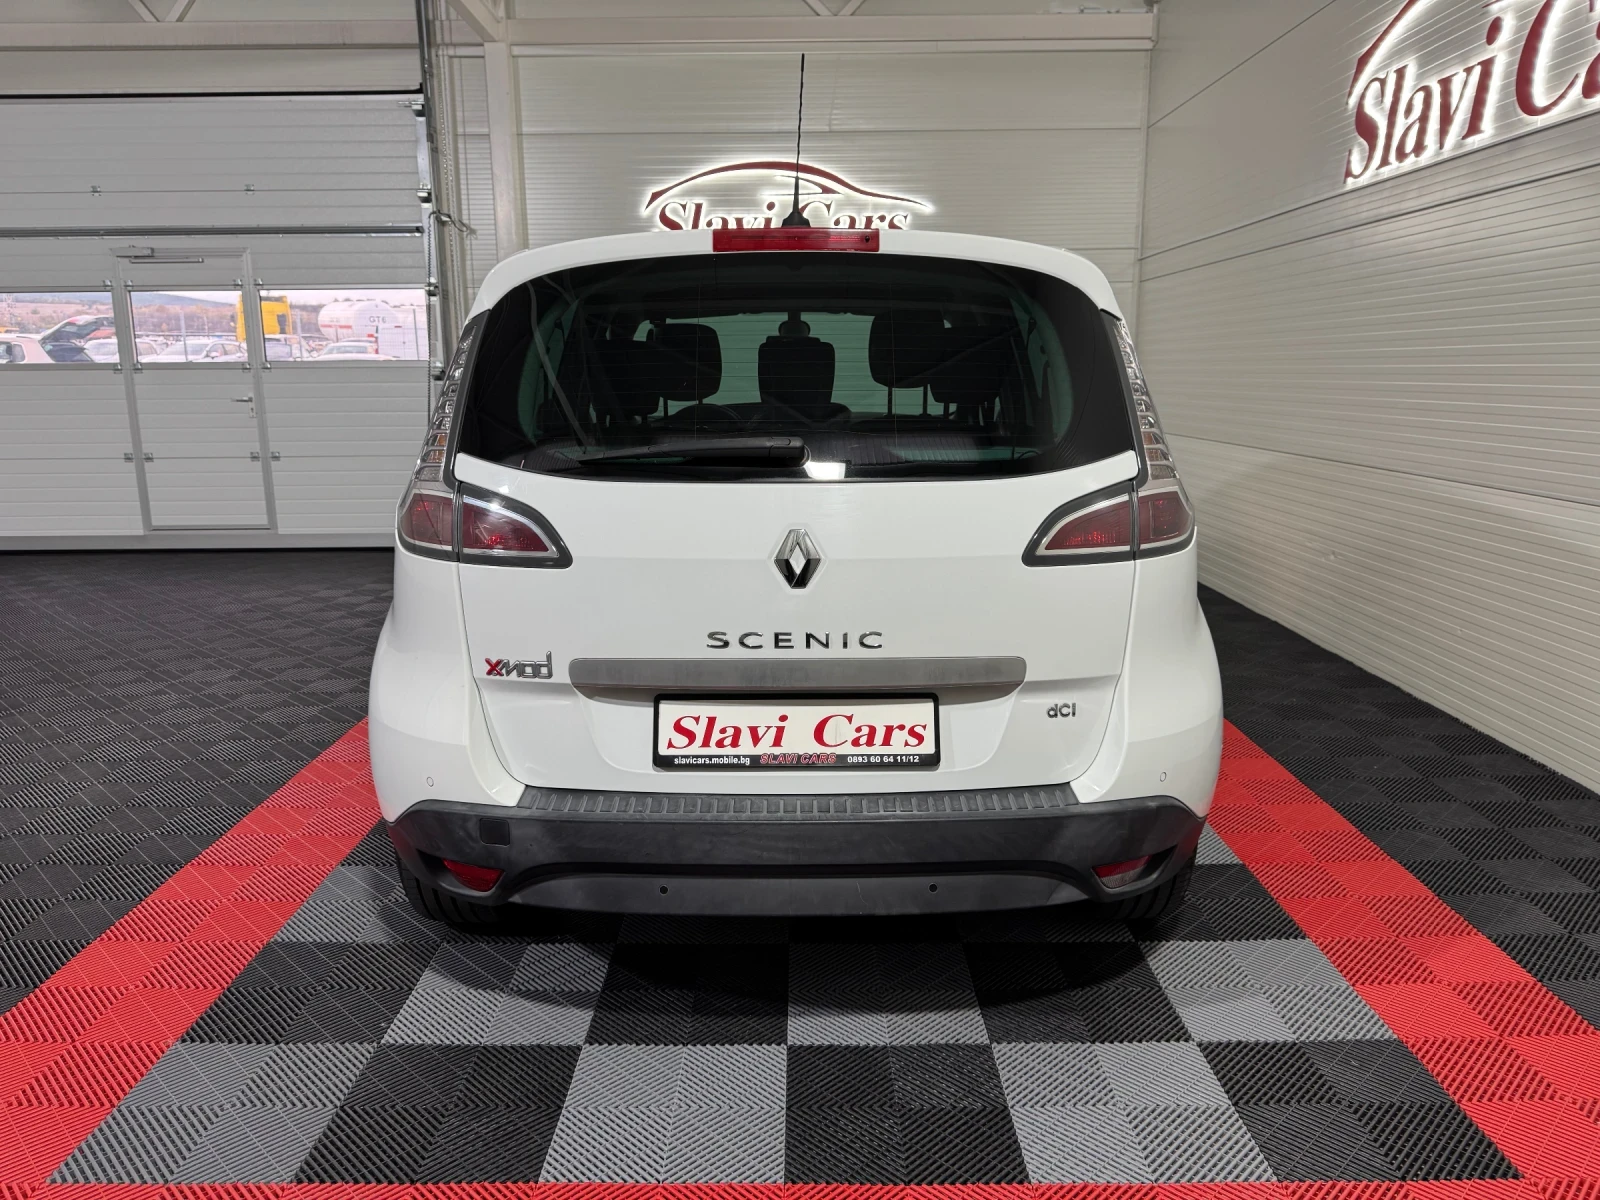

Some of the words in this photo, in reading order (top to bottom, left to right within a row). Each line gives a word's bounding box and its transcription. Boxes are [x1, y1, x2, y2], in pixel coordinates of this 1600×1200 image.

[1344, 16, 1503, 184] Slavi
[706, 631, 883, 650] SCENIC
[666, 714, 789, 750] Slavi
[813, 713, 928, 749] Cars
[674, 755, 751, 766] slavicars.mobile.bg
[759, 753, 797, 765] SLAVI
[800, 753, 837, 765] CARS
[847, 755, 868, 763] 0893
[870, 755, 881, 763] 60
[883, 755, 894, 763] 64
[896, 755, 920, 763] 11/12
